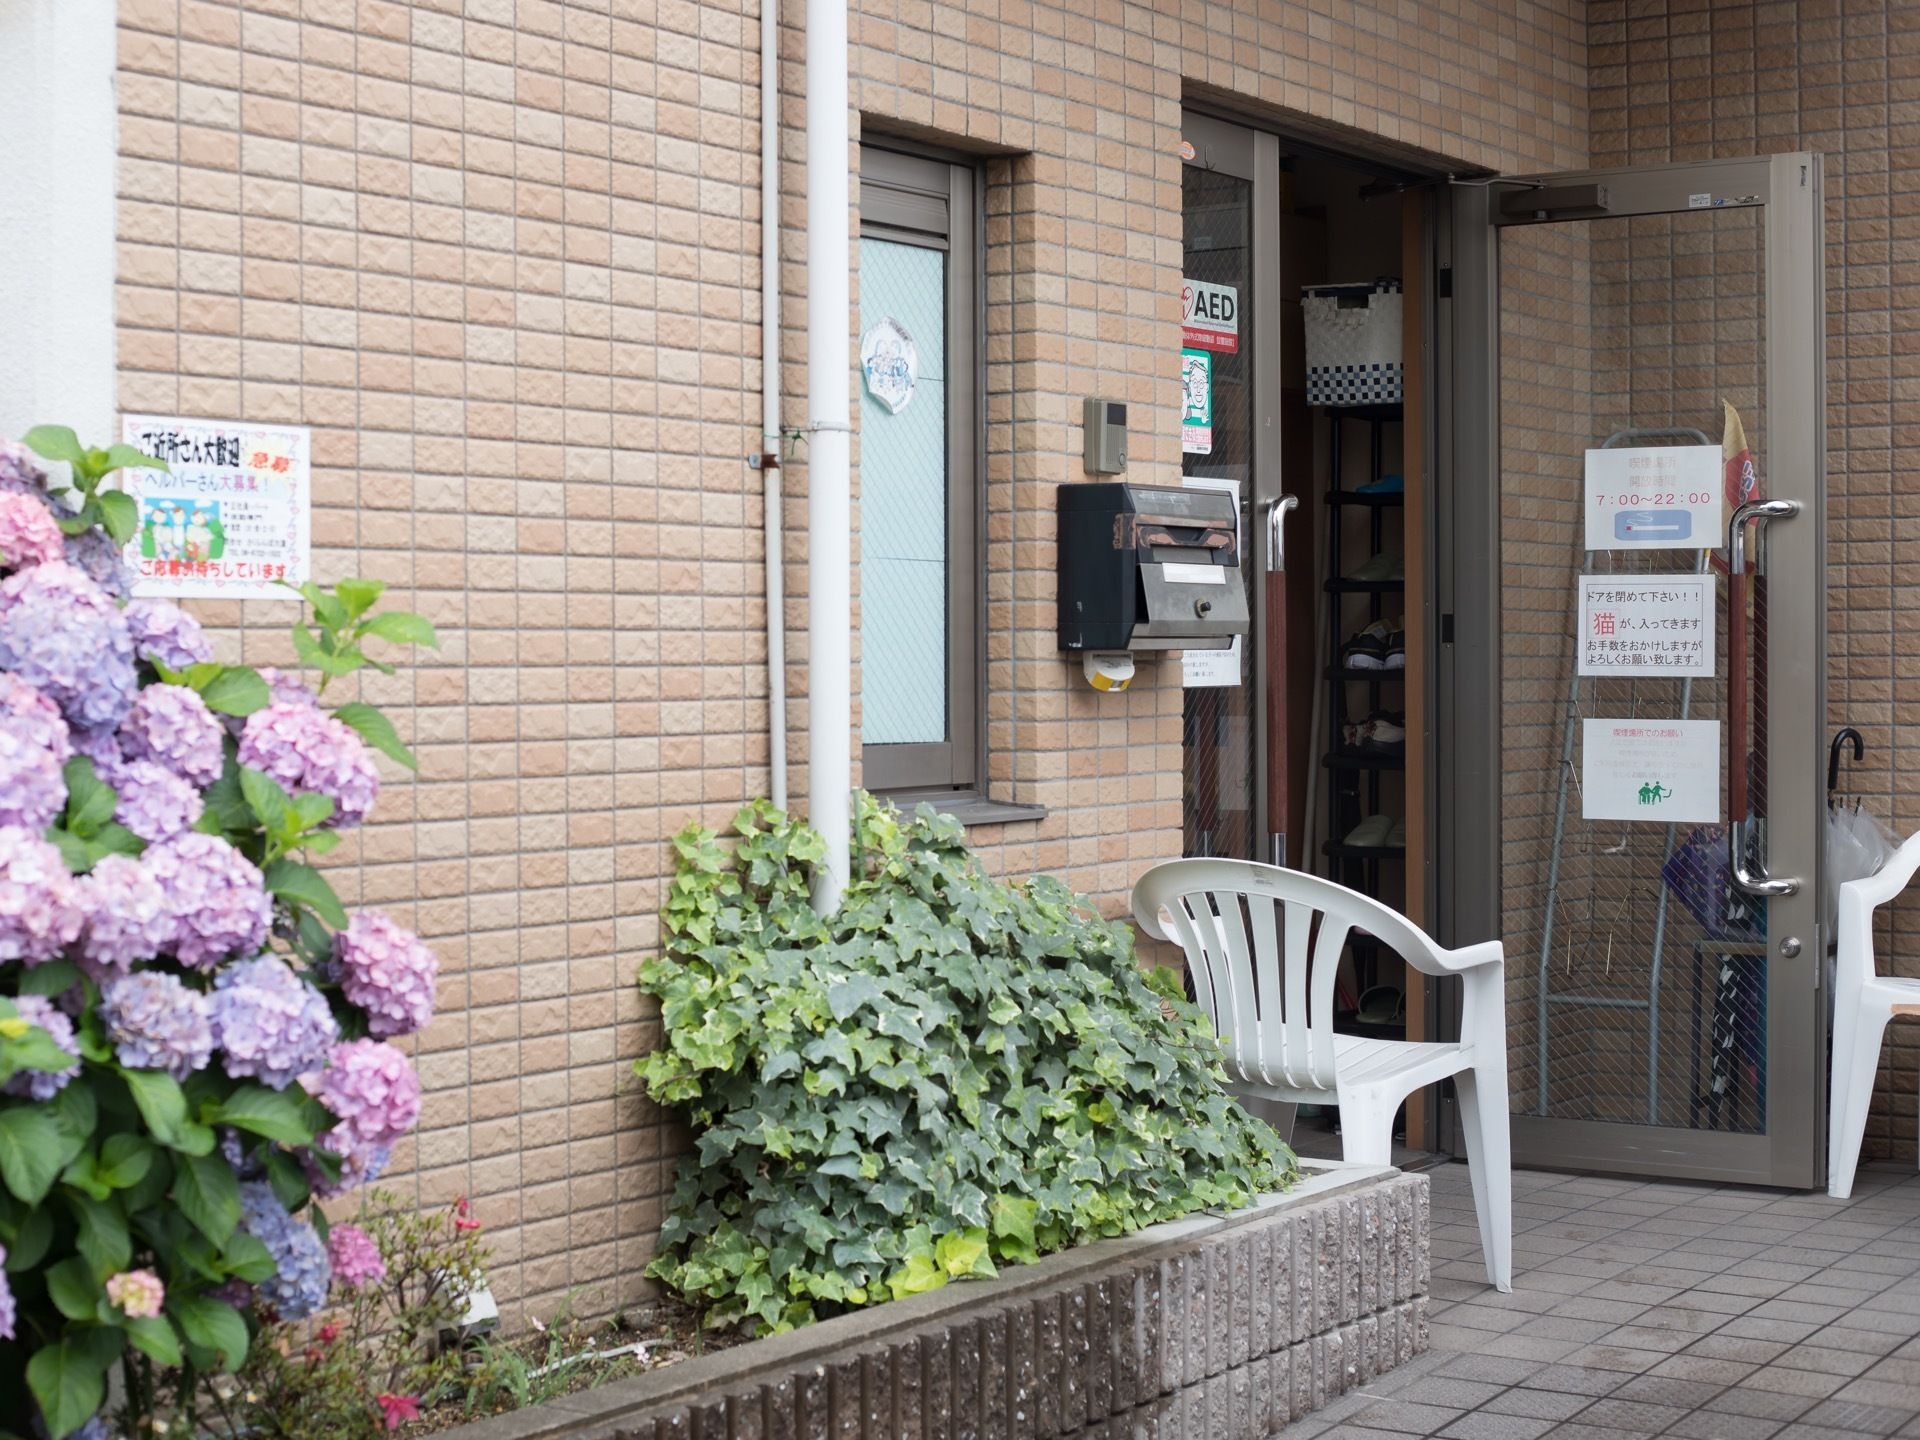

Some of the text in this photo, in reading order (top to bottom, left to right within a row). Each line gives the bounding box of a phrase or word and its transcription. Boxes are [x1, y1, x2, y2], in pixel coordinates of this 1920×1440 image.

[1194, 290, 1235, 321] AED
[1593, 612, 1616, 635] 猫
[1587, 640, 1702, 651] お手数をおかけしますが
